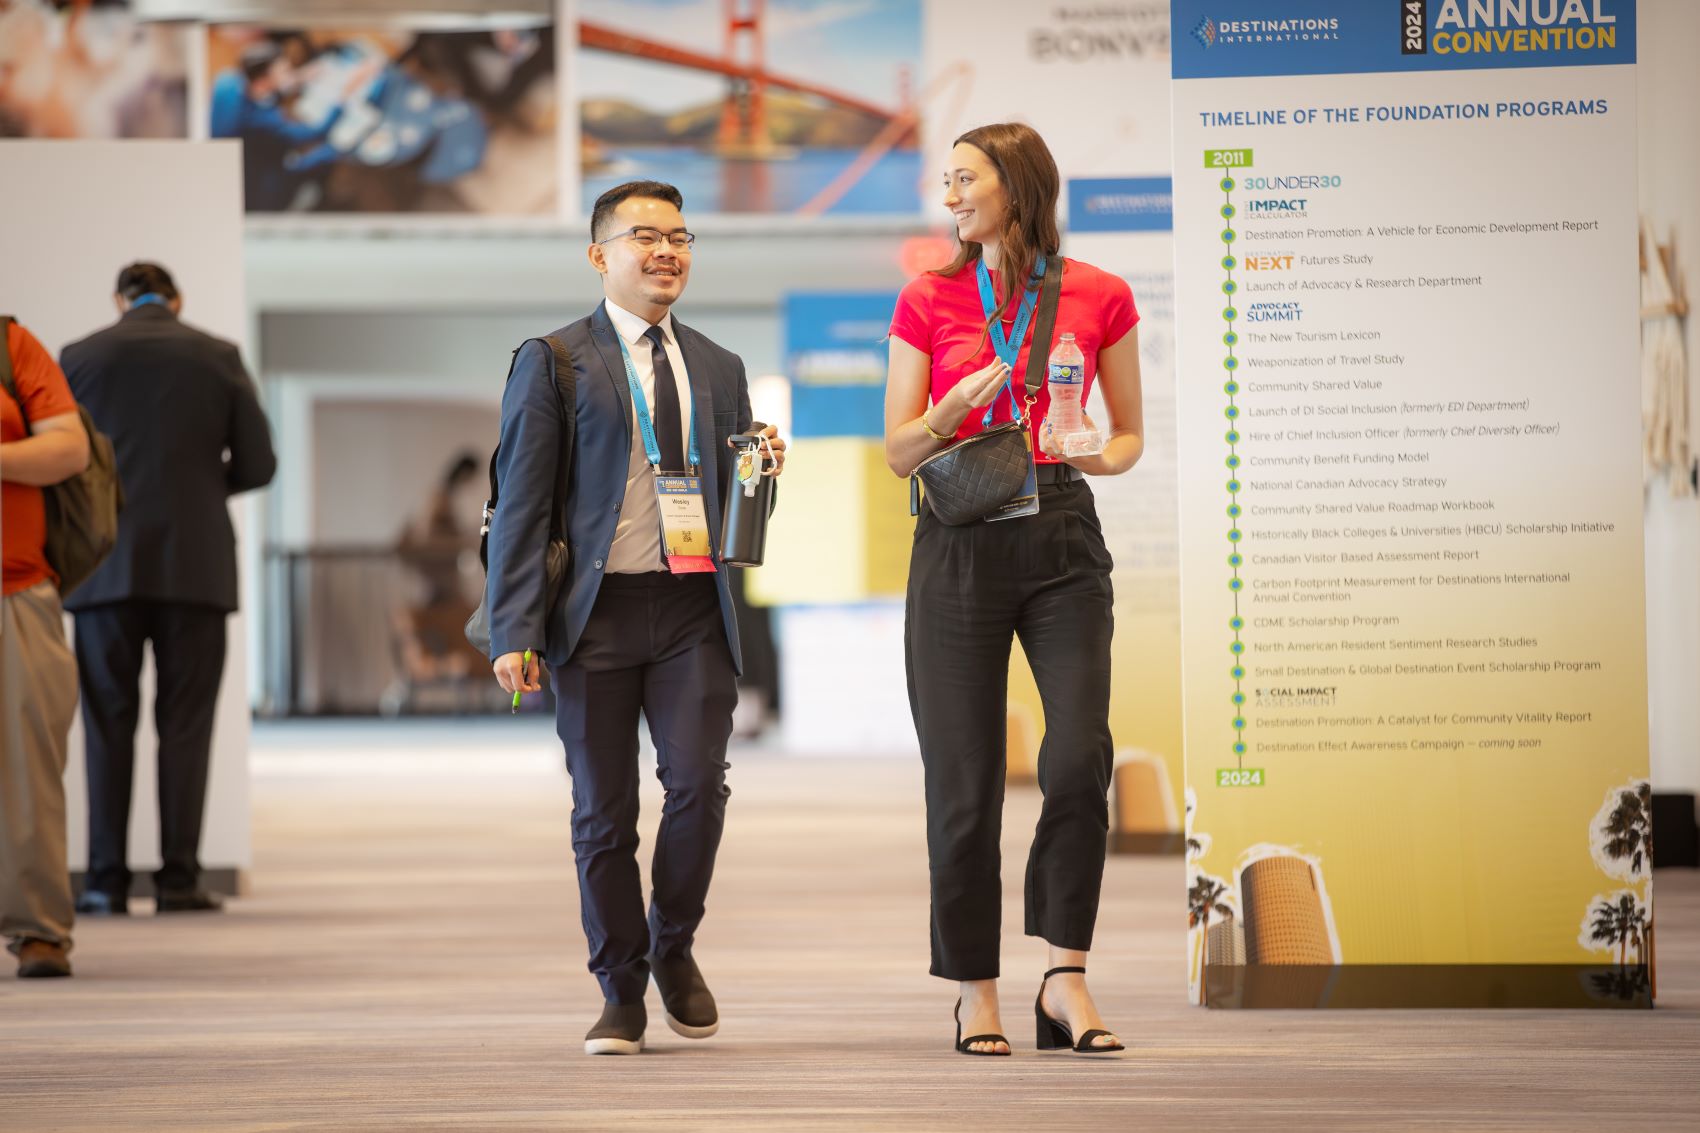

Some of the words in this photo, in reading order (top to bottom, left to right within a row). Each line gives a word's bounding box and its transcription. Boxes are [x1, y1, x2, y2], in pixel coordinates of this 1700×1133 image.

[1435, 0, 1616, 29] ANNUAL
[1220, 18, 1338, 33] DESTINATIONS
[1405, 0, 1423, 51] 2024
[1220, 32, 1338, 43] INTERNATIONAL
[1433, 26, 1616, 54] CONVENTION
[1200, 111, 1286, 127] TIMELINE
[1293, 109, 1317, 124] OF
[1323, 108, 1359, 123] THE
[1366, 104, 1489, 122] FOUNDATION
[1496, 100, 1608, 118] PROGRAMS
[1213, 152, 1244, 165] 2011
[1244, 176, 1341, 190] 30UNDER30
[1250, 199, 1307, 211] IMPACT
[1245, 230, 1303, 241] Destination
[1307, 228, 1361, 239] Promotion:
[1367, 227, 1374, 236] A
[1378, 225, 1414, 236] Vehicle
[1418, 225, 1432, 235] for
[1436, 224, 1486, 235] Economic
[1490, 221, 1558, 234] Development
[1563, 220, 1598, 232] Report
[1245, 256, 1294, 271] NEXT
[1301, 255, 1339, 265] Futures
[1343, 254, 1373, 265] Study
[1247, 281, 1285, 292] Launch
[1288, 280, 1297, 290] of
[1301, 279, 1350, 291] Advocacy
[1355, 278, 1362, 288] &
[1366, 277, 1414, 288] Research
[1418, 276, 1482, 288] Department
[1247, 310, 1303, 322] SUMMIT
[1249, 334, 1267, 343] The
[1271, 333, 1292, 342] New
[1296, 332, 1337, 341] Tourism
[1341, 330, 1380, 340] Lexicon
[1248, 357, 1323, 368] Weaponization
[1327, 356, 1336, 365] of
[1340, 355, 1371, 365] Travel
[1374, 355, 1404, 365] Study
[1249, 382, 1308, 392] Community
[1312, 381, 1350, 390] Shared
[1353, 380, 1382, 389] Value
[1249, 406, 1287, 417] Launch
[1291, 406, 1300, 415] of
[1304, 406, 1314, 415] DI
[1318, 405, 1348, 415] Social
[1352, 404, 1396, 414] Inclusion
[1401, 402, 1445, 414] (formerly
[1448, 402, 1464, 411] EDI
[1467, 398, 1529, 412] Department)
[1250, 431, 1270, 441] Hire
[1274, 431, 1283, 440] of
[1287, 430, 1313, 440] Chief
[1317, 429, 1361, 439] Inclusion
[1365, 428, 1399, 438] Officer
[1404, 426, 1447, 439] (formerly
[1451, 426, 1476, 436] Chief
[1479, 425, 1521, 437] Diversity
[1524, 422, 1560, 436] Officer)
[1250, 456, 1310, 466] Community
[1315, 455, 1350, 464] Benefit
[1353, 454, 1394, 464] Funding
[1398, 452, 1429, 462] Model
[1251, 480, 1292, 490] National
[1296, 479, 1344, 490] Canadian
[1349, 478, 1398, 489] Advocacy
[1402, 477, 1447, 488] Strategy
[1252, 505, 1311, 516] Community
[1315, 504, 1352, 513] Shared
[1356, 503, 1384, 513] Value
[1388, 501, 1438, 512] Roadmap
[1441, 500, 1495, 511] Workbook
[1252, 529, 1308, 540] Historically
[1312, 528, 1339, 538] Black
[1343, 527, 1387, 538] Colleges
[1391, 527, 1397, 537] &
[1401, 526, 1461, 536] Universities
[1465, 524, 1502, 538] (HBCU)
[1507, 523, 1567, 535] Scholarship
[1571, 522, 1614, 533] Initiative
[1252, 554, 1300, 564] Canadian
[1305, 554, 1336, 564] Visitor
[1341, 552, 1373, 562] Based
[1377, 551, 1440, 562] Assessment
[1444, 551, 1479, 561] Report
[1253, 579, 1291, 589] Carbon
[1295, 578, 1340, 589] Footprint
[1344, 577, 1415, 587] Measurement
[1419, 575, 1433, 585] for
[1437, 574, 1500, 585] Destinations
[1505, 572, 1570, 583] International
[1253, 593, 1289, 603] Annual
[1293, 592, 1351, 602] Convention
[1254, 618, 1285, 628] CDME
[1289, 616, 1349, 627] Scholarship
[1353, 616, 1399, 626] Program
[1254, 643, 1284, 652] North
[1288, 642, 1337, 651] American
[1342, 640, 1385, 650] Resident
[1389, 639, 1442, 649] Sentiment
[1446, 638, 1495, 648] Research
[1499, 637, 1538, 648] Studies
[1256, 667, 1283, 677] Small
[1287, 665, 1345, 676] Destination
[1349, 665, 1355, 674] &
[1360, 664, 1392, 674] Global
[1395, 663, 1453, 674] Destination
[1458, 663, 1485, 673] Event
[1489, 662, 1550, 673] Scholarship
[1554, 661, 1600, 671] Program
[1297, 687, 1337, 696] IMPACT
[1256, 697, 1337, 707] ASSESSMENT
[1256, 717, 1313, 728] Destination
[1318, 716, 1372, 727] Promotion:
[1377, 716, 1384, 725] A
[1388, 714, 1430, 725] Catalyst
[1434, 714, 1447, 724] for
[1452, 713, 1513, 725] Community
[1517, 712, 1552, 724] Vitality
[1556, 712, 1591, 723] Report
[1257, 742, 1314, 753] Destination
[1319, 741, 1347, 751] Effect
[1352, 740, 1408, 750] Awareness
[1411, 739, 1464, 752] Campaign
[1479, 739, 1514, 749] coming
[1518, 739, 1541, 748] soon
[1221, 771, 1261, 785] 2024
